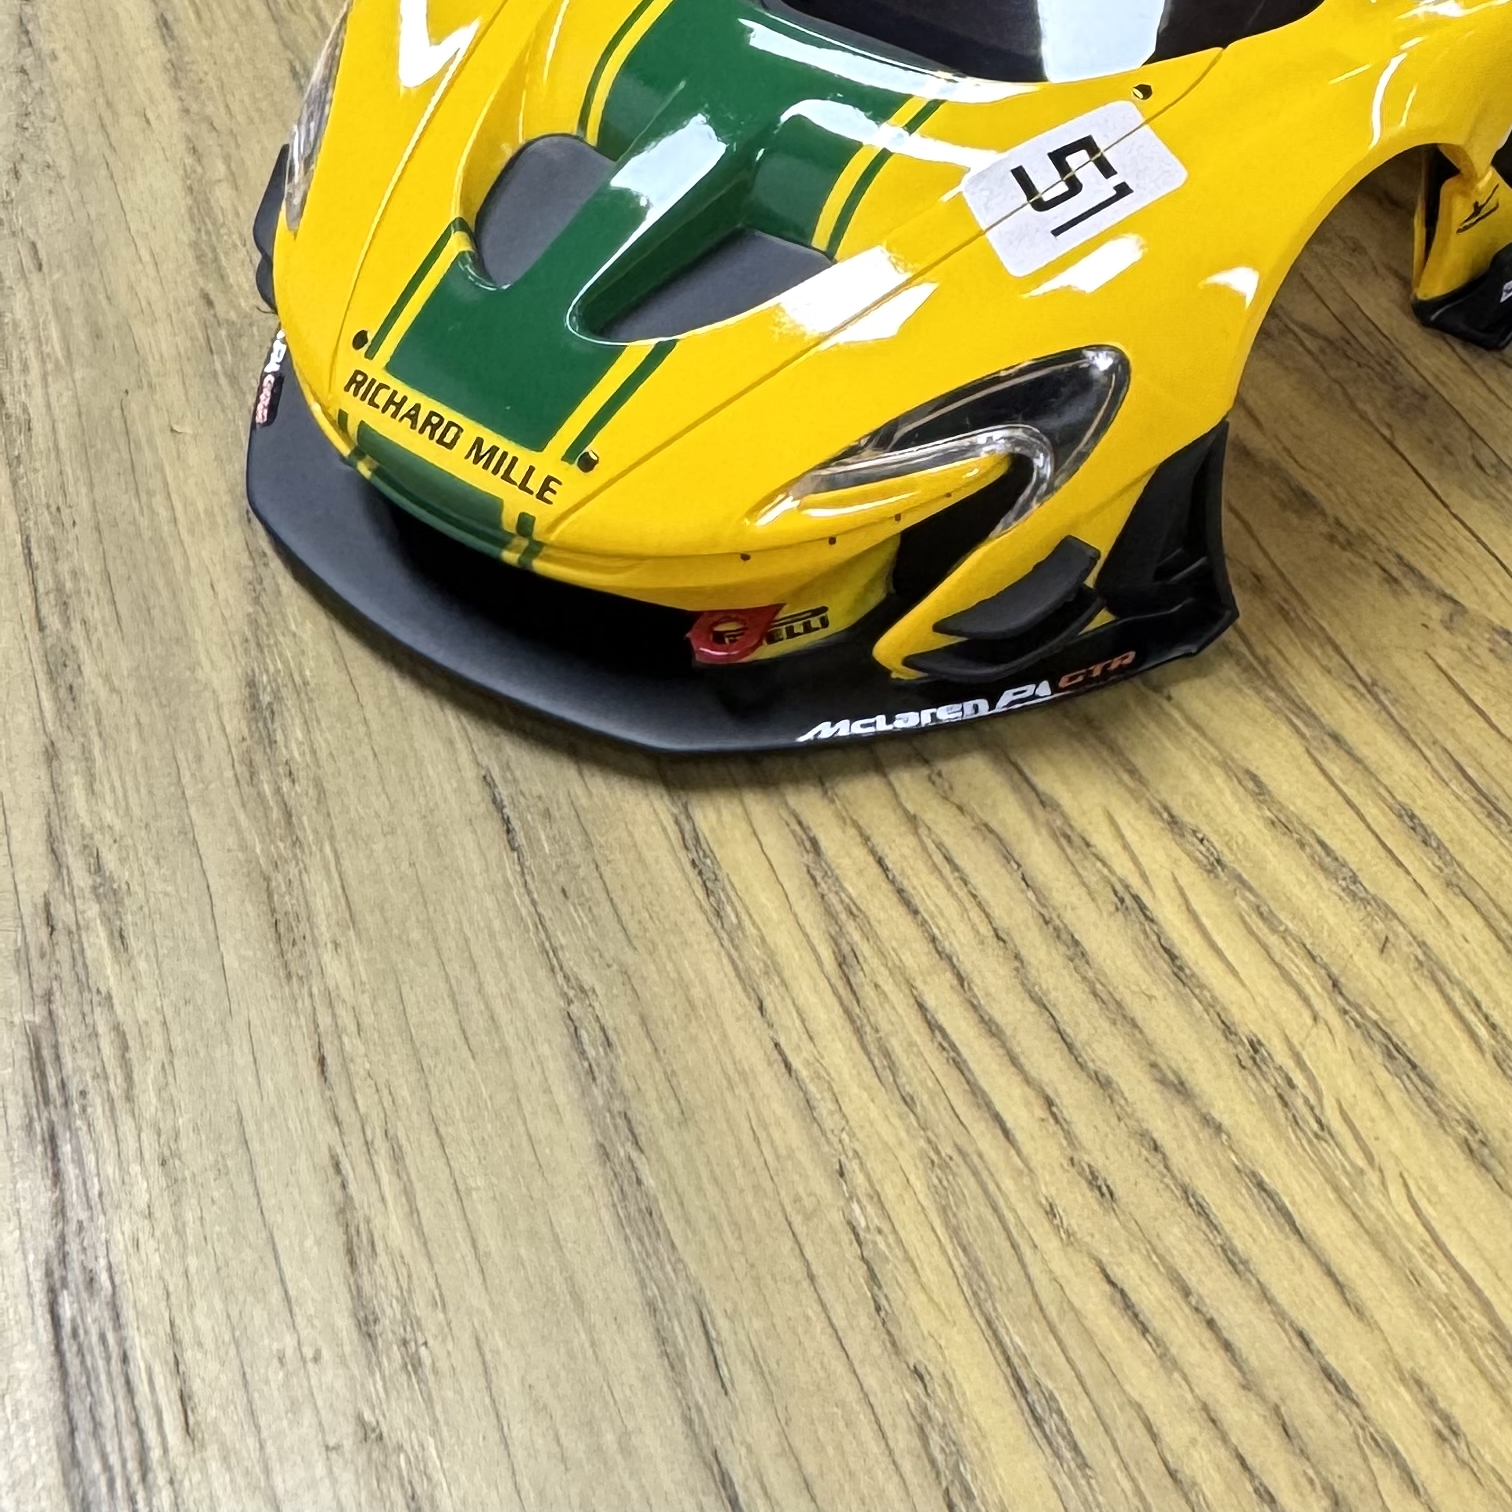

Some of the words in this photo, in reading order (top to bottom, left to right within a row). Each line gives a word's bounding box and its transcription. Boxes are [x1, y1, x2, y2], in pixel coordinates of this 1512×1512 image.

[1010, 134, 1134, 238] 51
[343, 369, 464, 451] RICHARD
[464, 437, 563, 505] MILLE
[797, 698, 989, 742] McLaren
